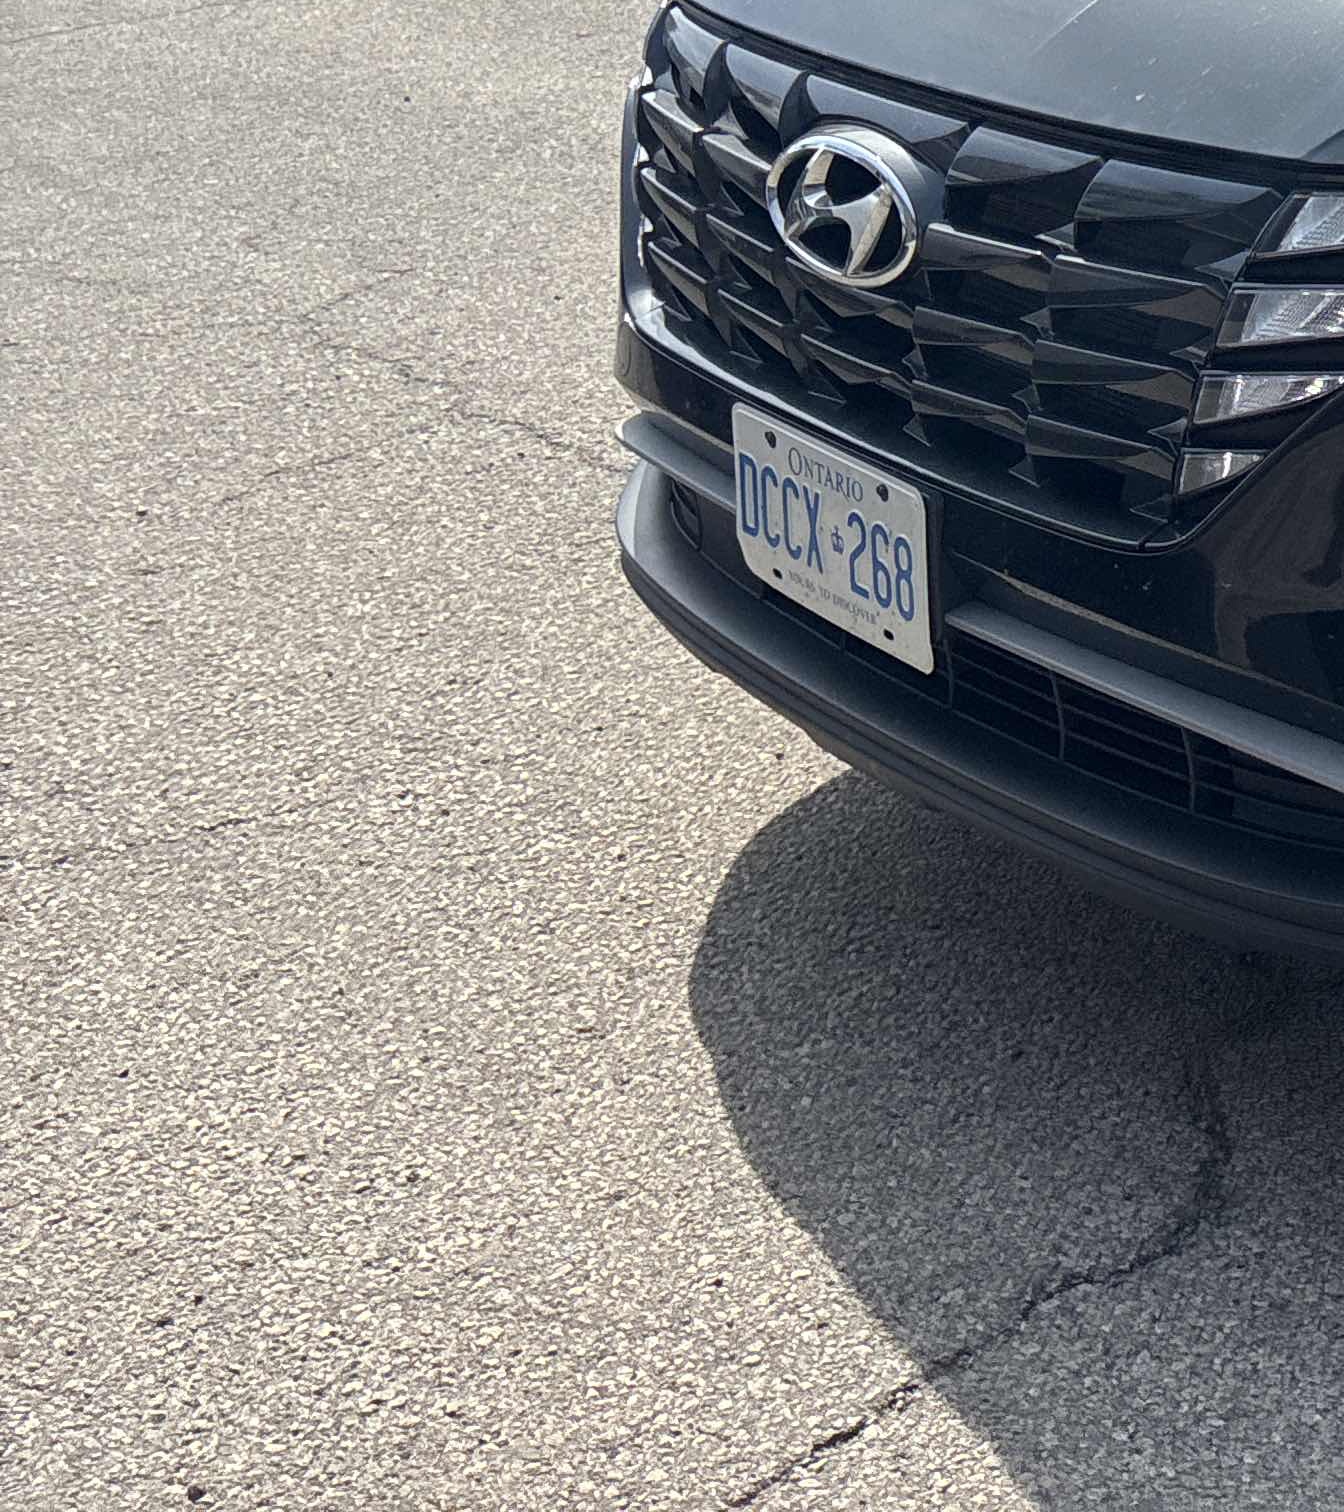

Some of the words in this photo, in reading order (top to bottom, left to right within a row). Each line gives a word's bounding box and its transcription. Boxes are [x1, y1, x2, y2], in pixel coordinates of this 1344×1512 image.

[788, 447, 864, 503] ONTARIO
[739, 452, 824, 574] DCCX
[847, 511, 914, 622] 268
